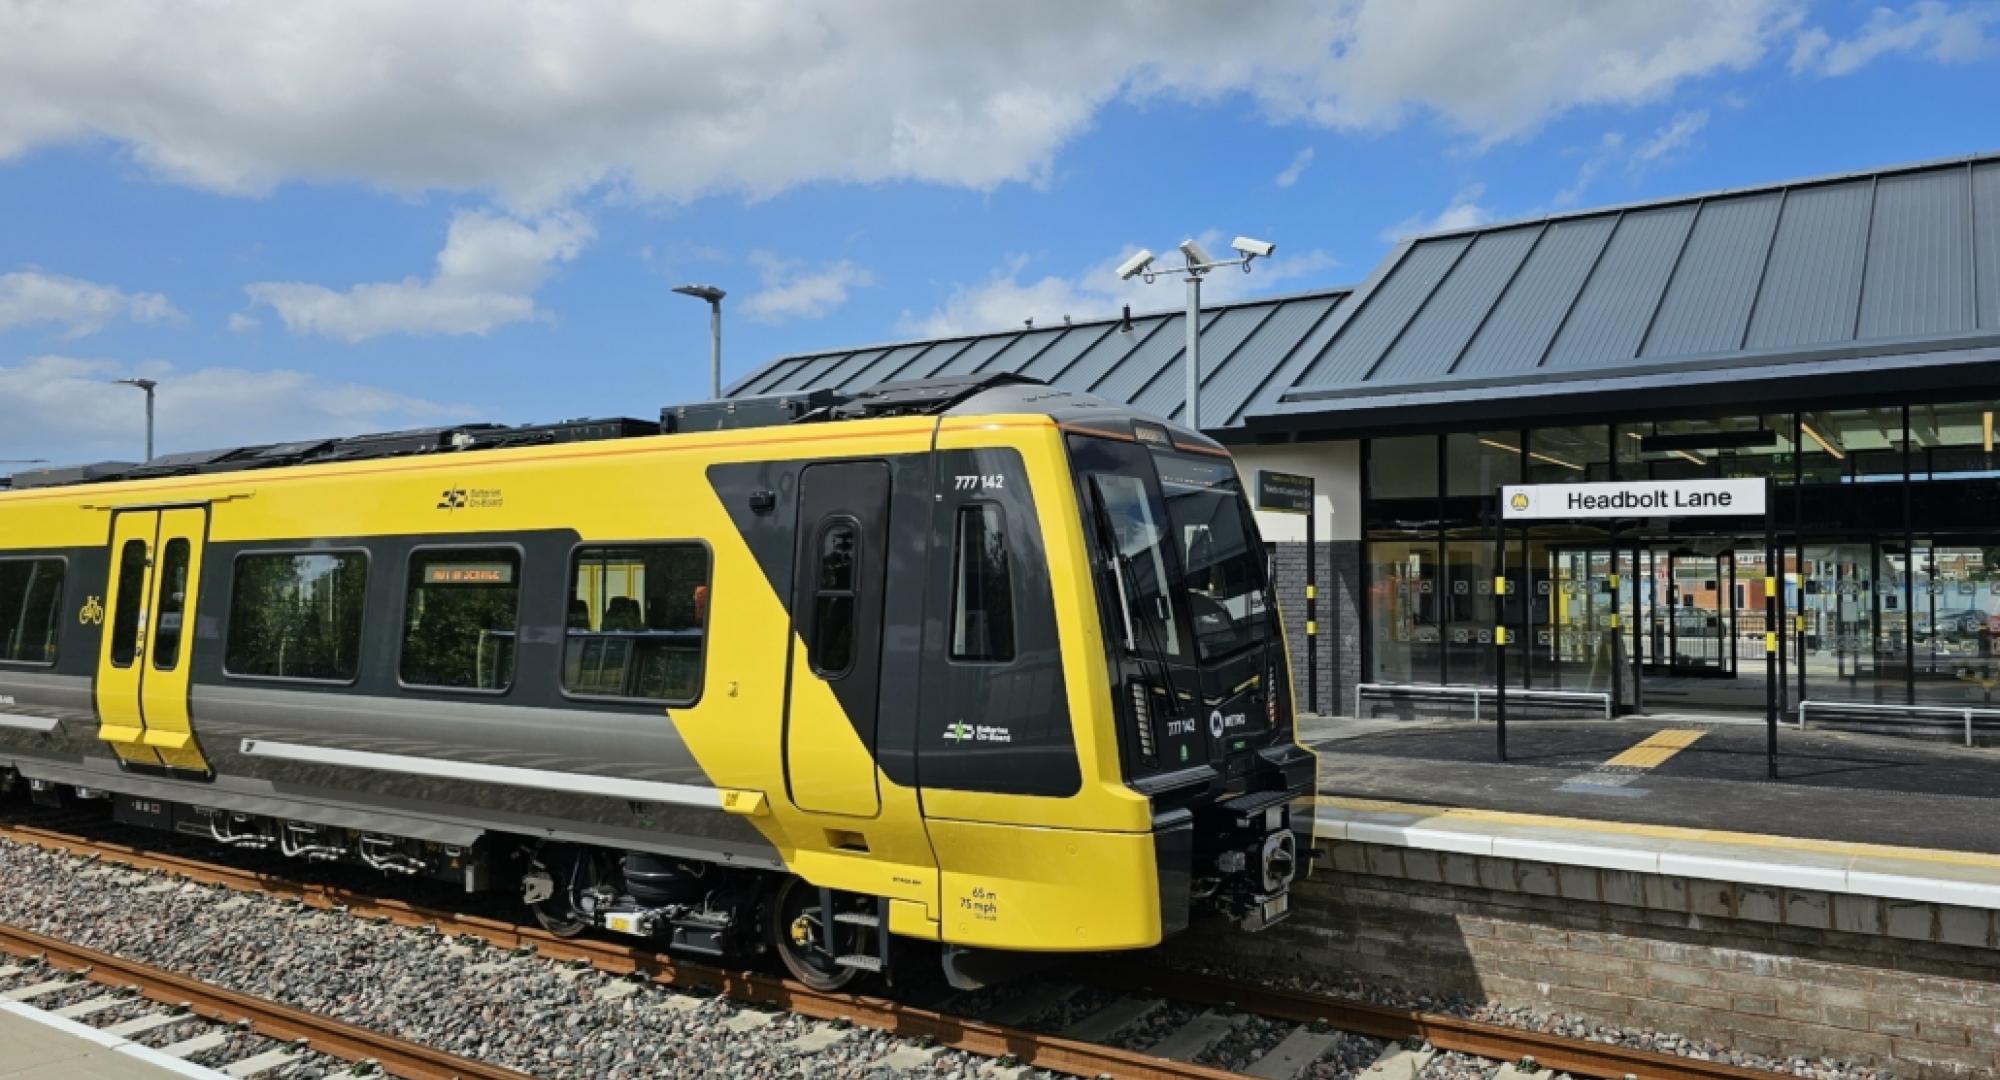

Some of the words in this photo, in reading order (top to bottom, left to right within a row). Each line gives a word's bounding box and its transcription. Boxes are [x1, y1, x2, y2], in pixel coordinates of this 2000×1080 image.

[954, 475, 979, 490] 777
[981, 474, 1005, 489] 142
[1567, 490, 1668, 510] Headbolt
[1675, 489, 1733, 508] Lane
[1167, 720, 1181, 736] 777
[1182, 718, 1196, 732] 142
[960, 896, 972, 910] 75
[974, 902, 997, 915] mph
